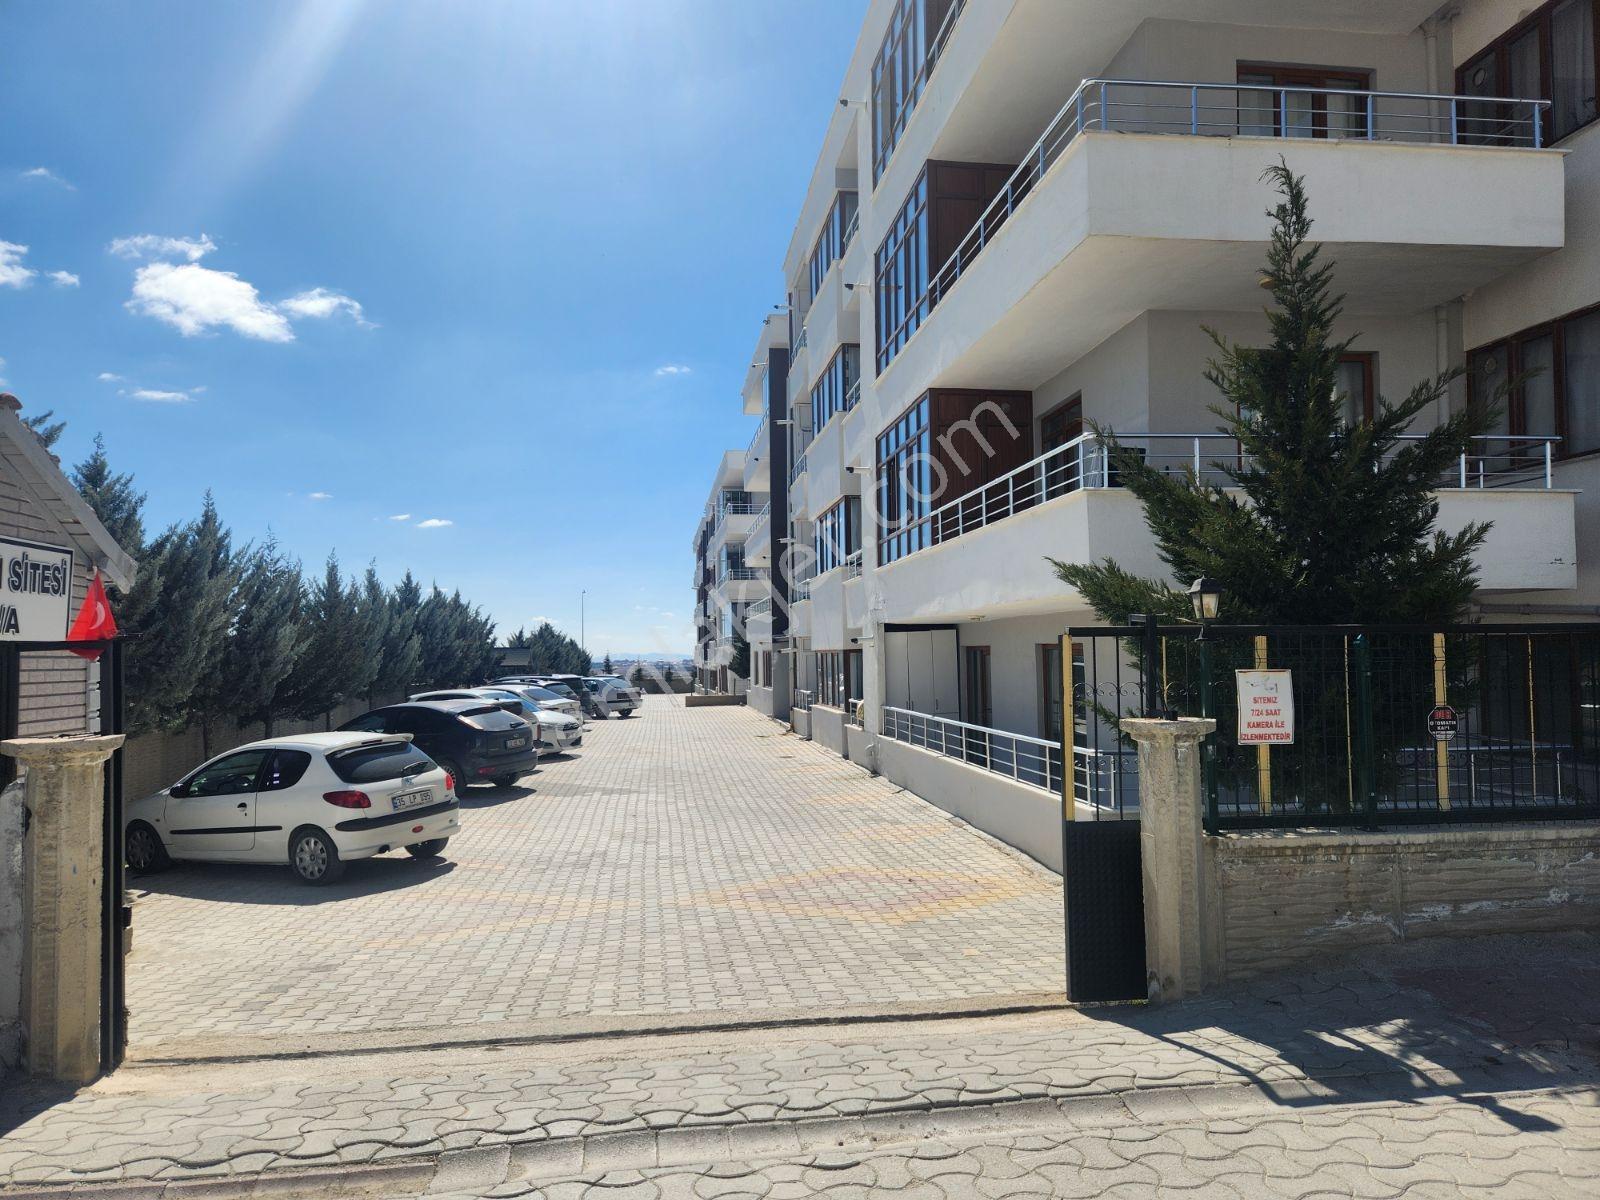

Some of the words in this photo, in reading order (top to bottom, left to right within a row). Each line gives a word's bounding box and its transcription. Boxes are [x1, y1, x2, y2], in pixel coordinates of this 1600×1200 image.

[9, 552, 67, 596] SİTESİ
[1265, 708, 1281, 717] SAAT
[1247, 721, 1273, 729] KAMERA
